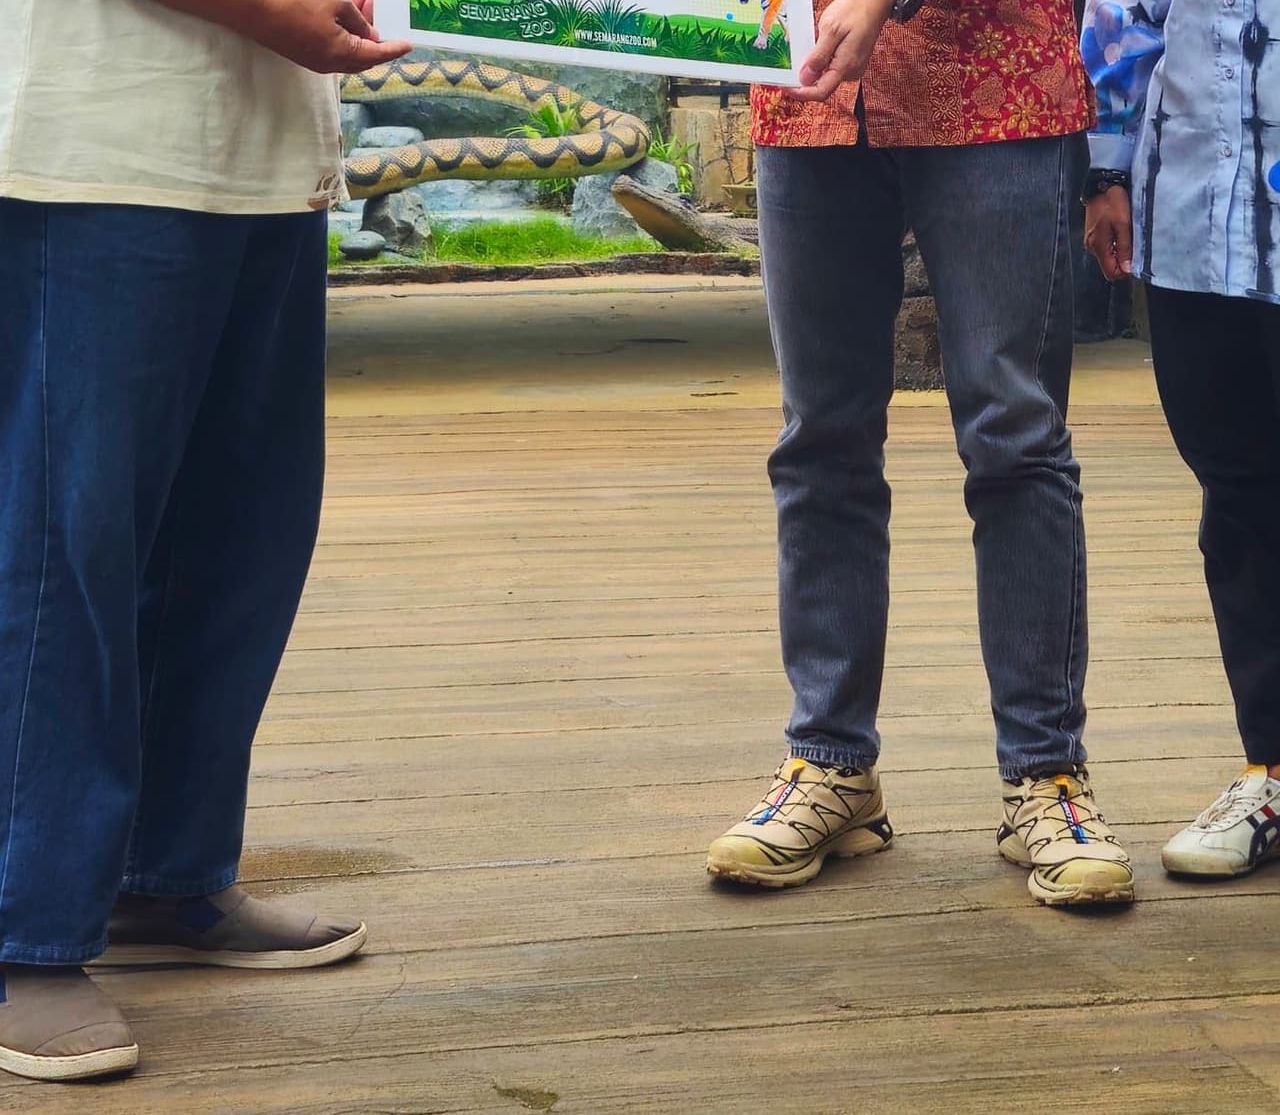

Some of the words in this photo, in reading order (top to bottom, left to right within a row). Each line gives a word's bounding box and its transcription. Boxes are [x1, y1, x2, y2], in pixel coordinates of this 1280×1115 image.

[458, 0, 548, 22] SEMARANG
[520, 18, 556, 38] ZOO
[574, 28, 658, 49] WWW.SEMARANGZOO.COM
